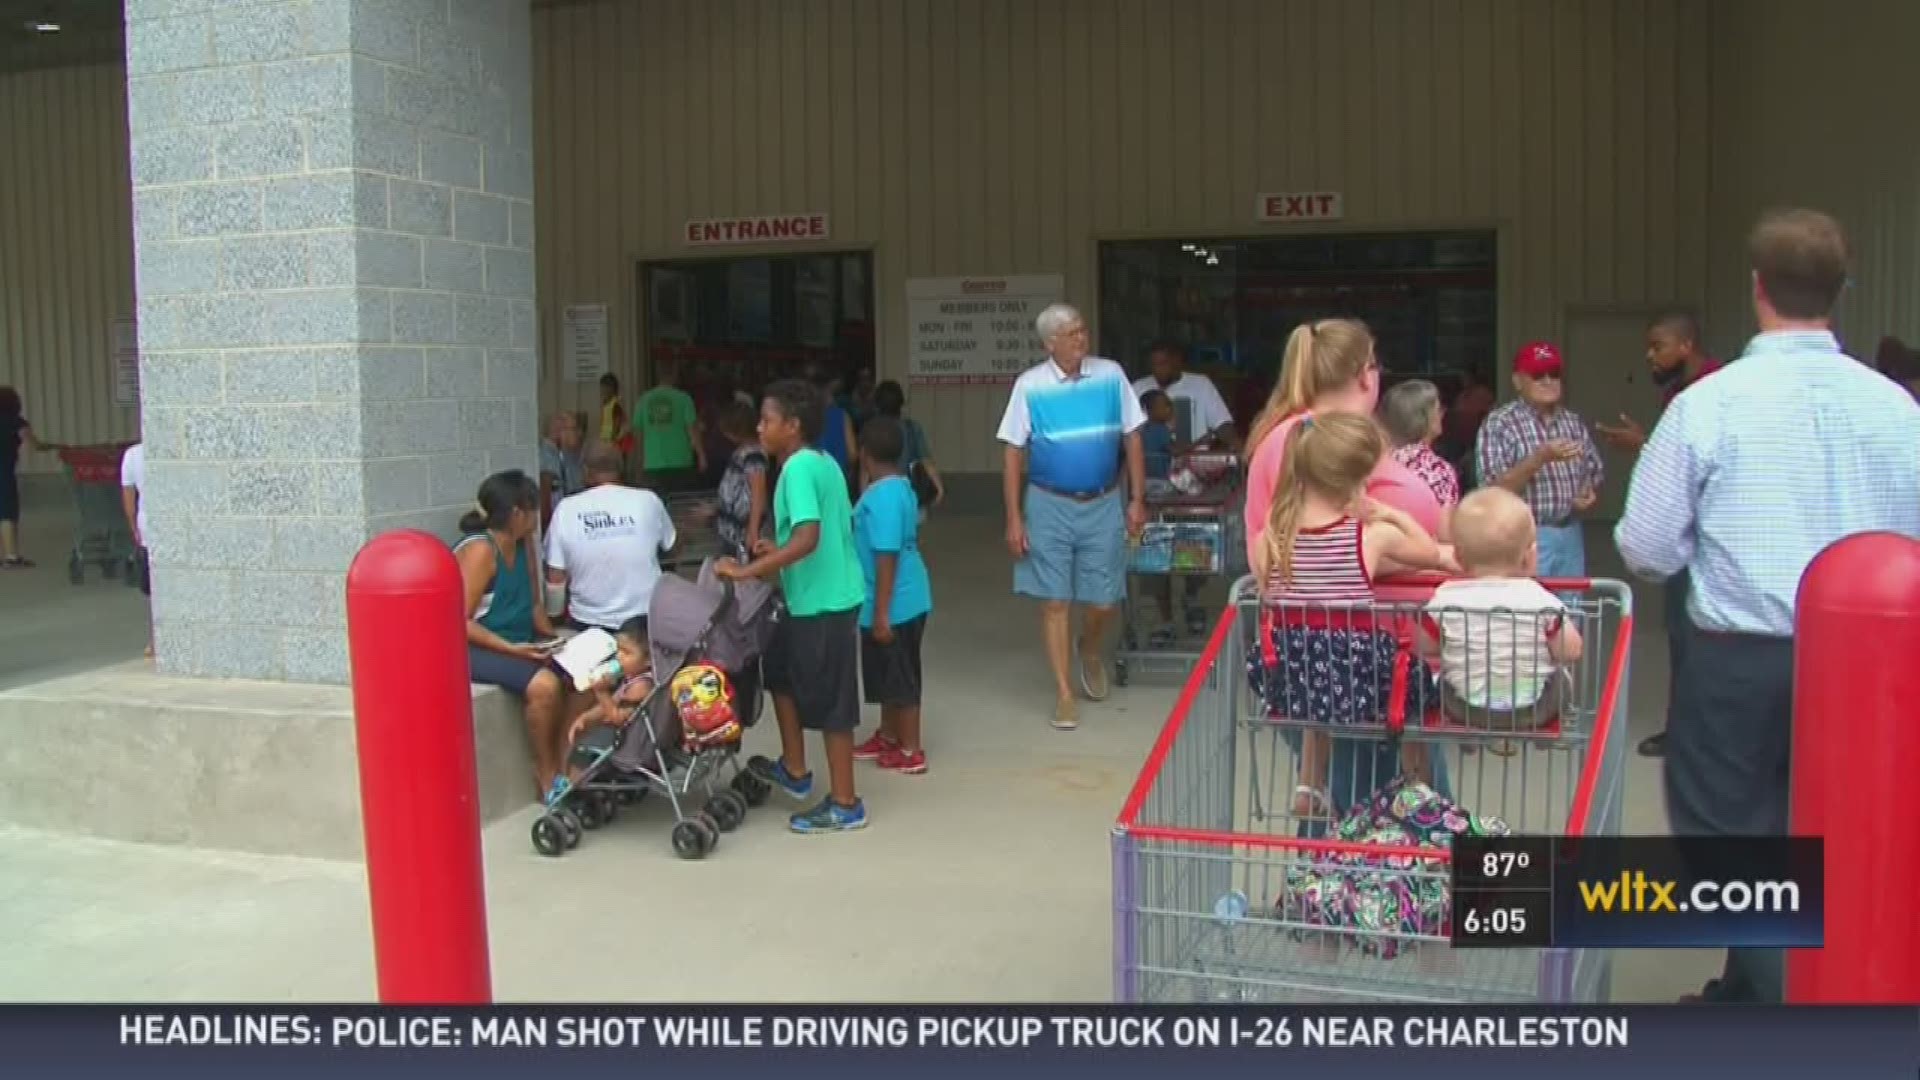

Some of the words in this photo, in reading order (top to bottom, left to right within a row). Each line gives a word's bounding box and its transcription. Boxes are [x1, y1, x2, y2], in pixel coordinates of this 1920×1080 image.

[1265, 194, 1333, 217] EXIT
[688, 215, 824, 242] ENTRANCE
[939, 301, 997, 314] MEMBERS
[1000, 300, 1028, 313] ONLY
[918, 321, 945, 333] MON
[953, 320, 973, 332] FRI
[919, 339, 977, 351] SATURDAY
[919, 359, 963, 372] SUNDAY
